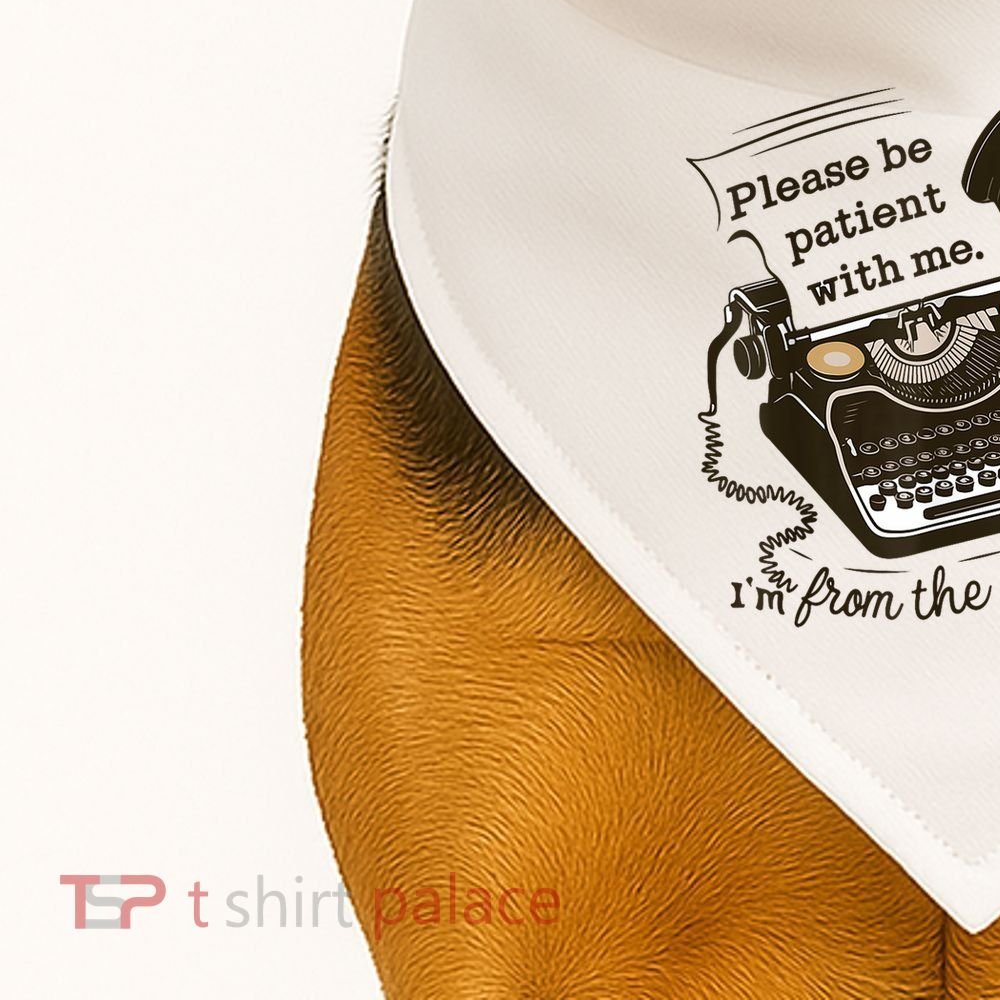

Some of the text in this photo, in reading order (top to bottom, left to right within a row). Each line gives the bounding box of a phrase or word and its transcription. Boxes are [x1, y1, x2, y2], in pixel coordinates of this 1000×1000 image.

[726, 136, 933, 222] Please be
[785, 183, 946, 266] patient
[807, 239, 984, 307] with me.
[730, 576, 786, 614] I'm
[795, 566, 904, 628] from
[911, 565, 992, 621] the
